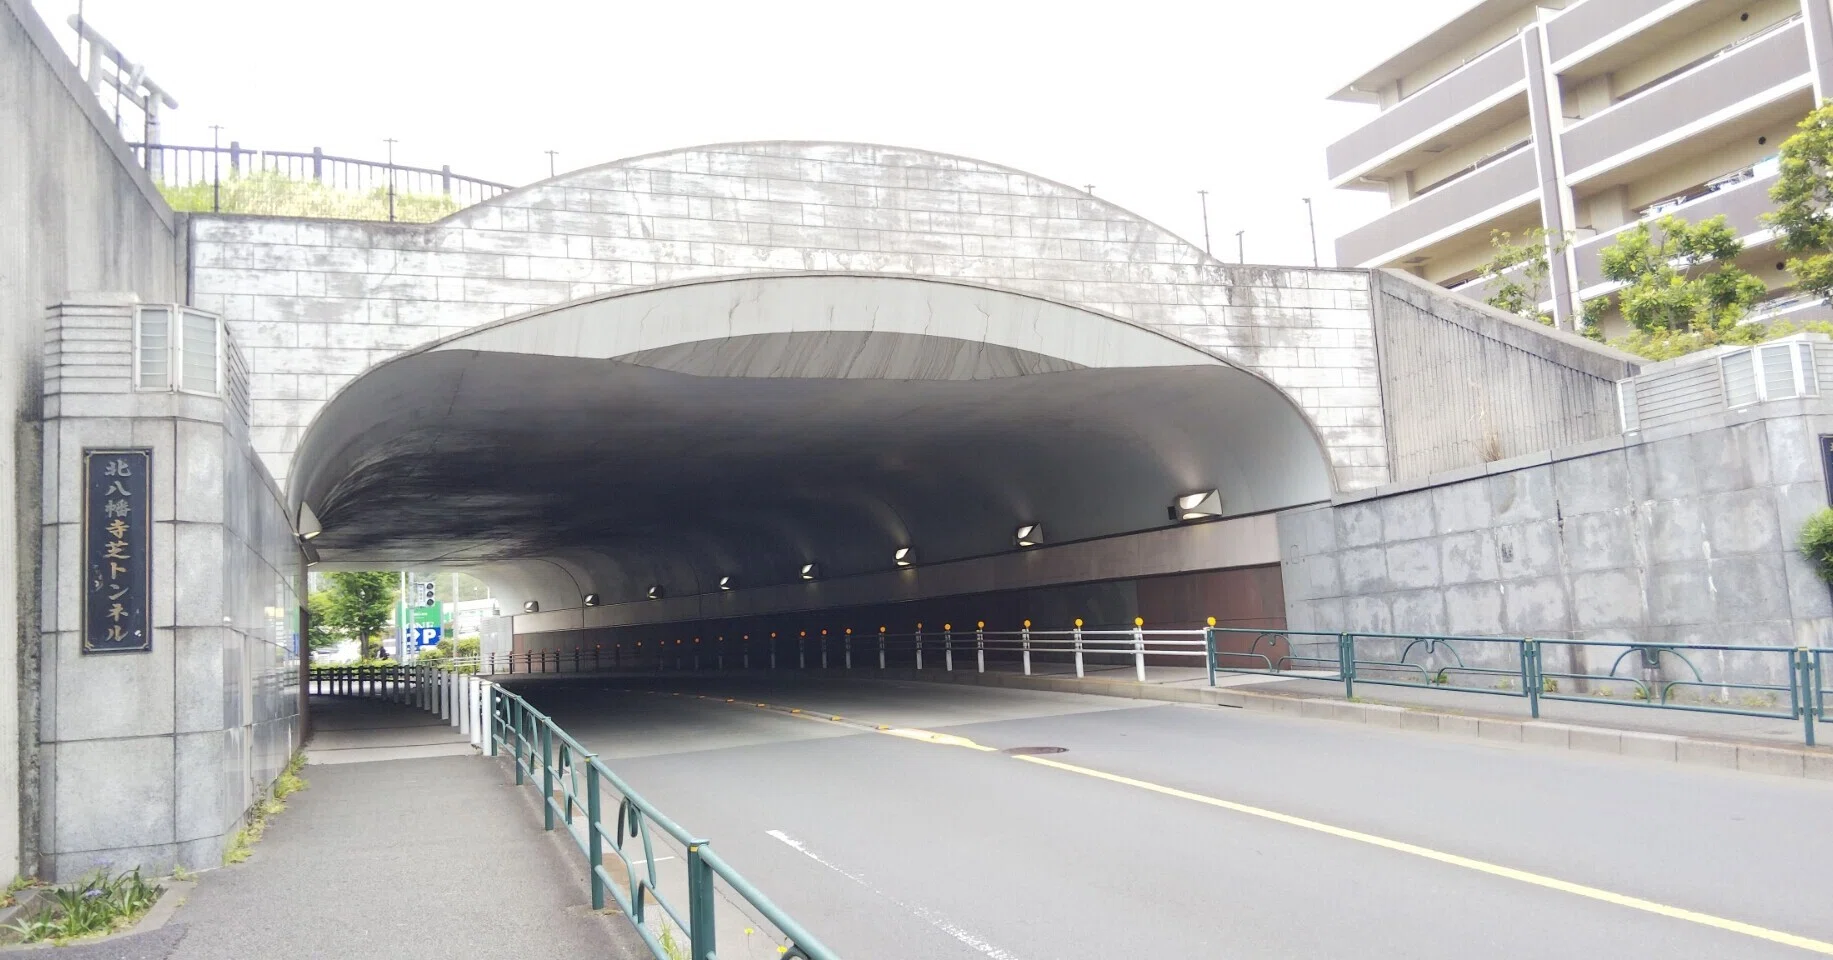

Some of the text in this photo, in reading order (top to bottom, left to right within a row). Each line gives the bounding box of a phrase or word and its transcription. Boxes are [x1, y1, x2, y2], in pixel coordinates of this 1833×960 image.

[103, 459, 132, 642] 北八幡寺芝トンネル
[422, 628, 437, 644] P
